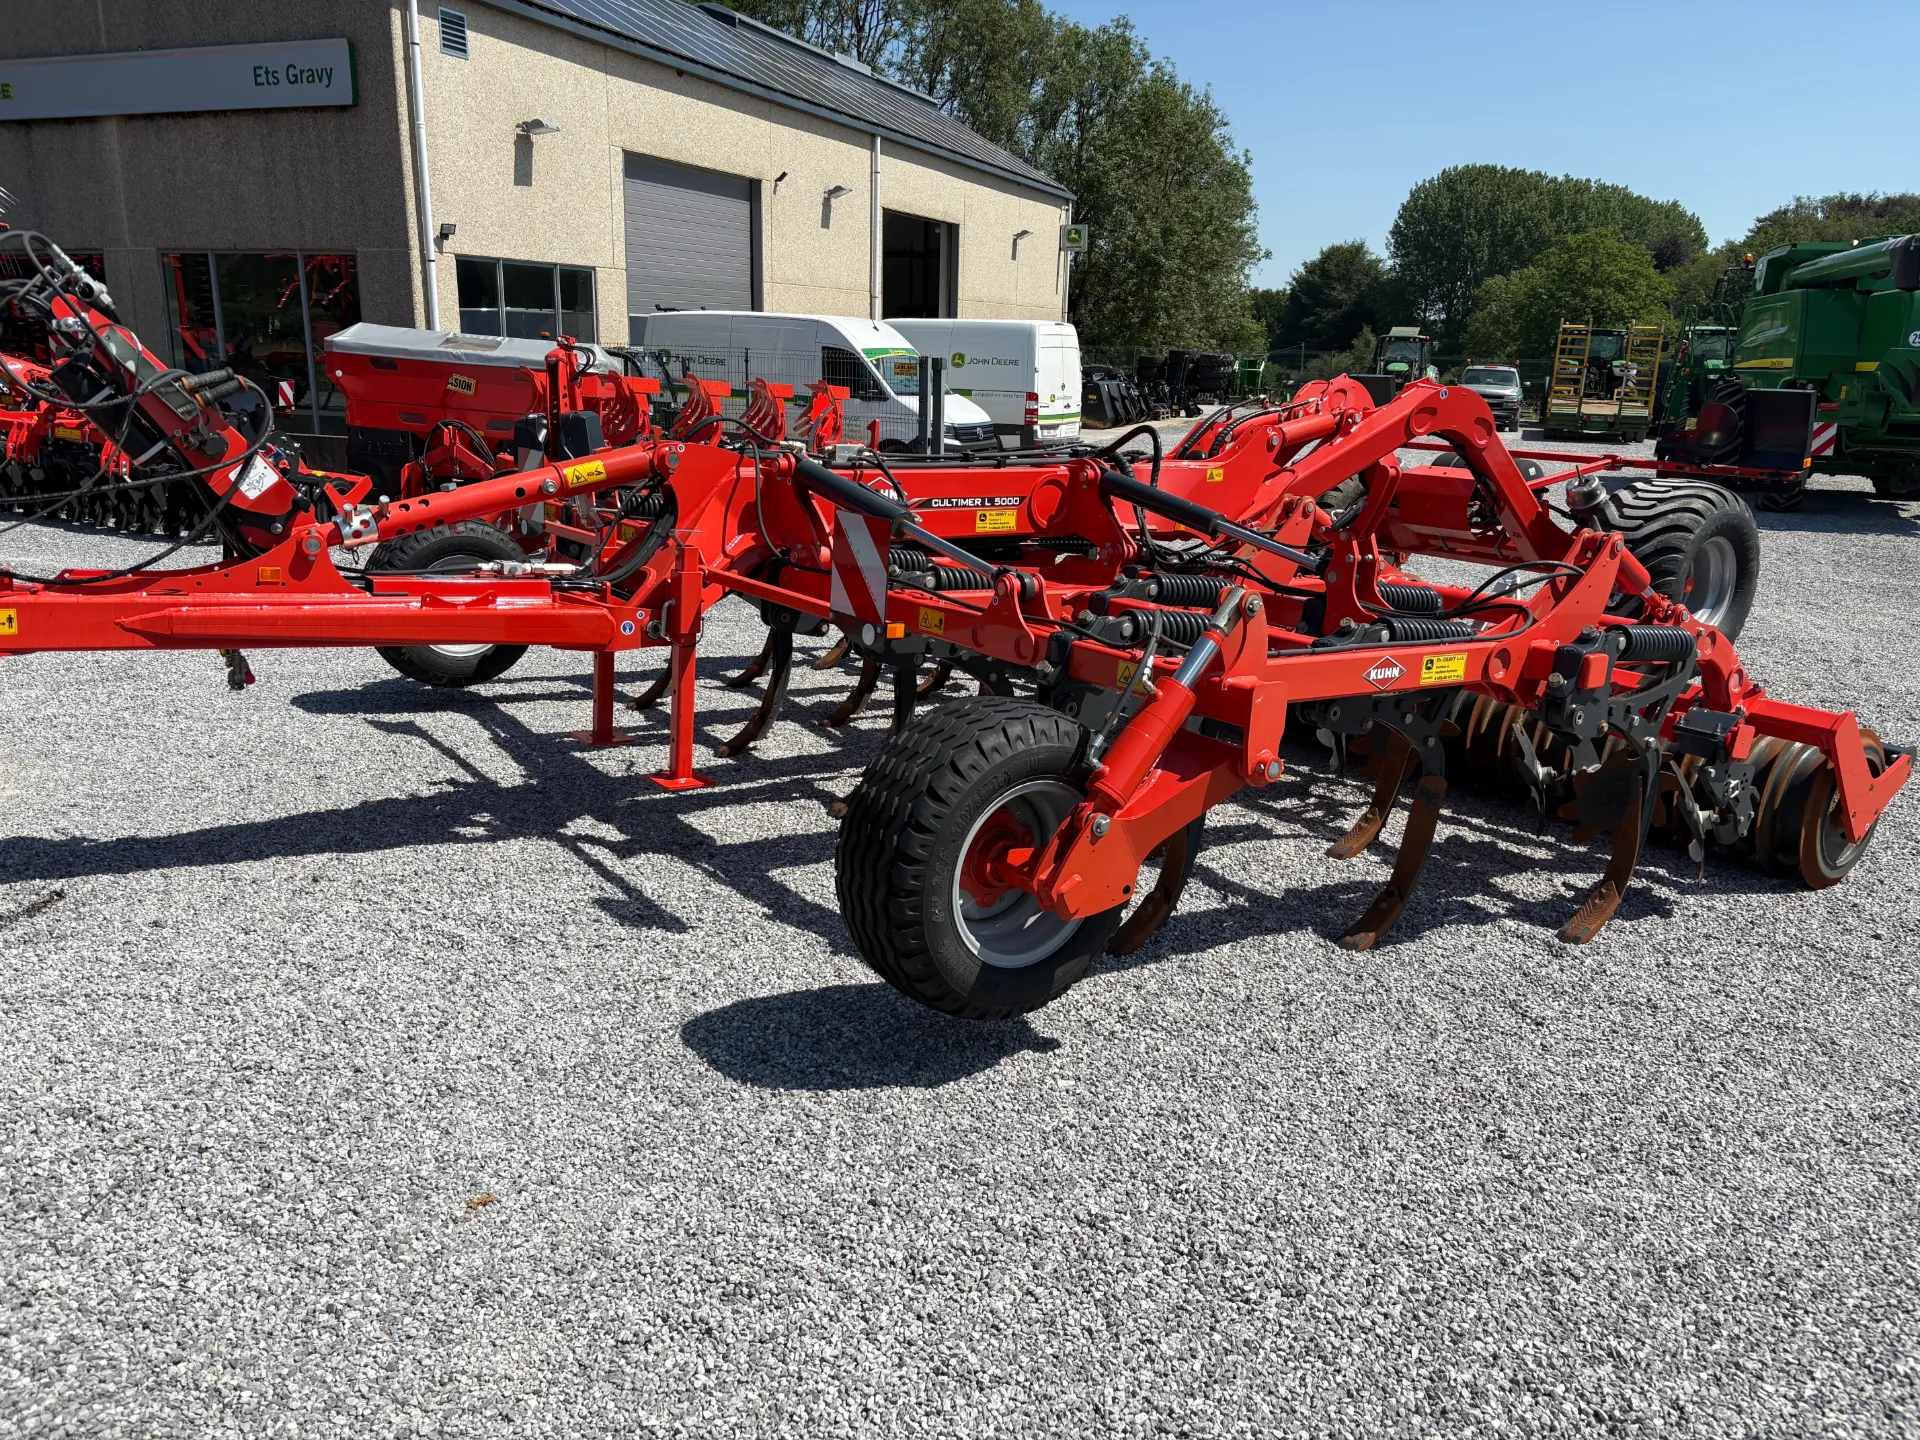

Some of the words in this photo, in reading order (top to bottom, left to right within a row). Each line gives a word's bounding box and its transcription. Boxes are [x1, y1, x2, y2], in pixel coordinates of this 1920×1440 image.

[253, 66, 280, 86] Ets
[285, 63, 334, 88] Gravy
[967, 357, 990, 365] JOHN
[991, 357, 1020, 366] DEERE
[932, 498, 981, 507] CULTIMER
[985, 498, 992, 506] L
[994, 497, 1020, 505] 5000
[1369, 666, 1400, 680] KUHN
